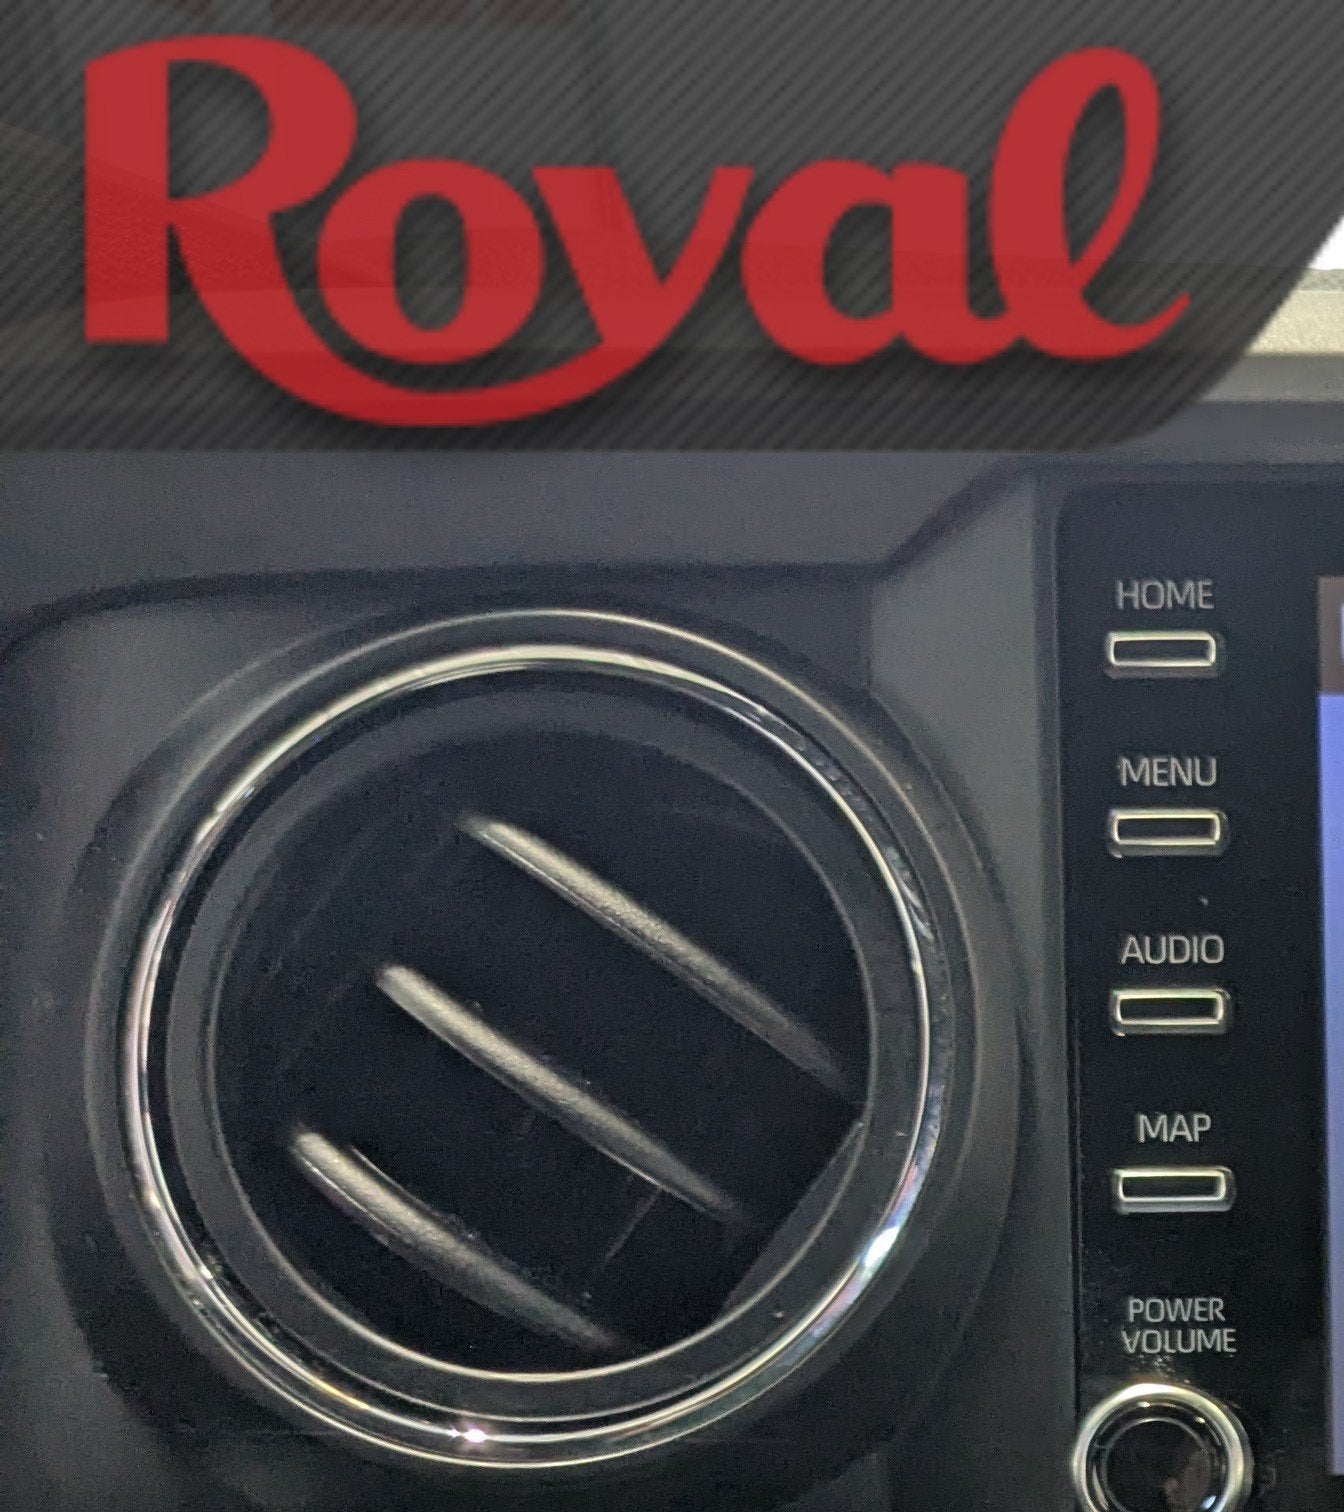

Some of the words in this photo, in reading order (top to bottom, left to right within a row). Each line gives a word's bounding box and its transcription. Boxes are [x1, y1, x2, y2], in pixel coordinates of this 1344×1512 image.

[1116, 579, 1214, 610] HOME
[1117, 756, 1217, 787] MENU
[1120, 934, 1225, 965] AUDIO
[1137, 1113, 1212, 1143] MAP
[1127, 1296, 1226, 1323] POWER
[1121, 1326, 1237, 1354] VOLUME
